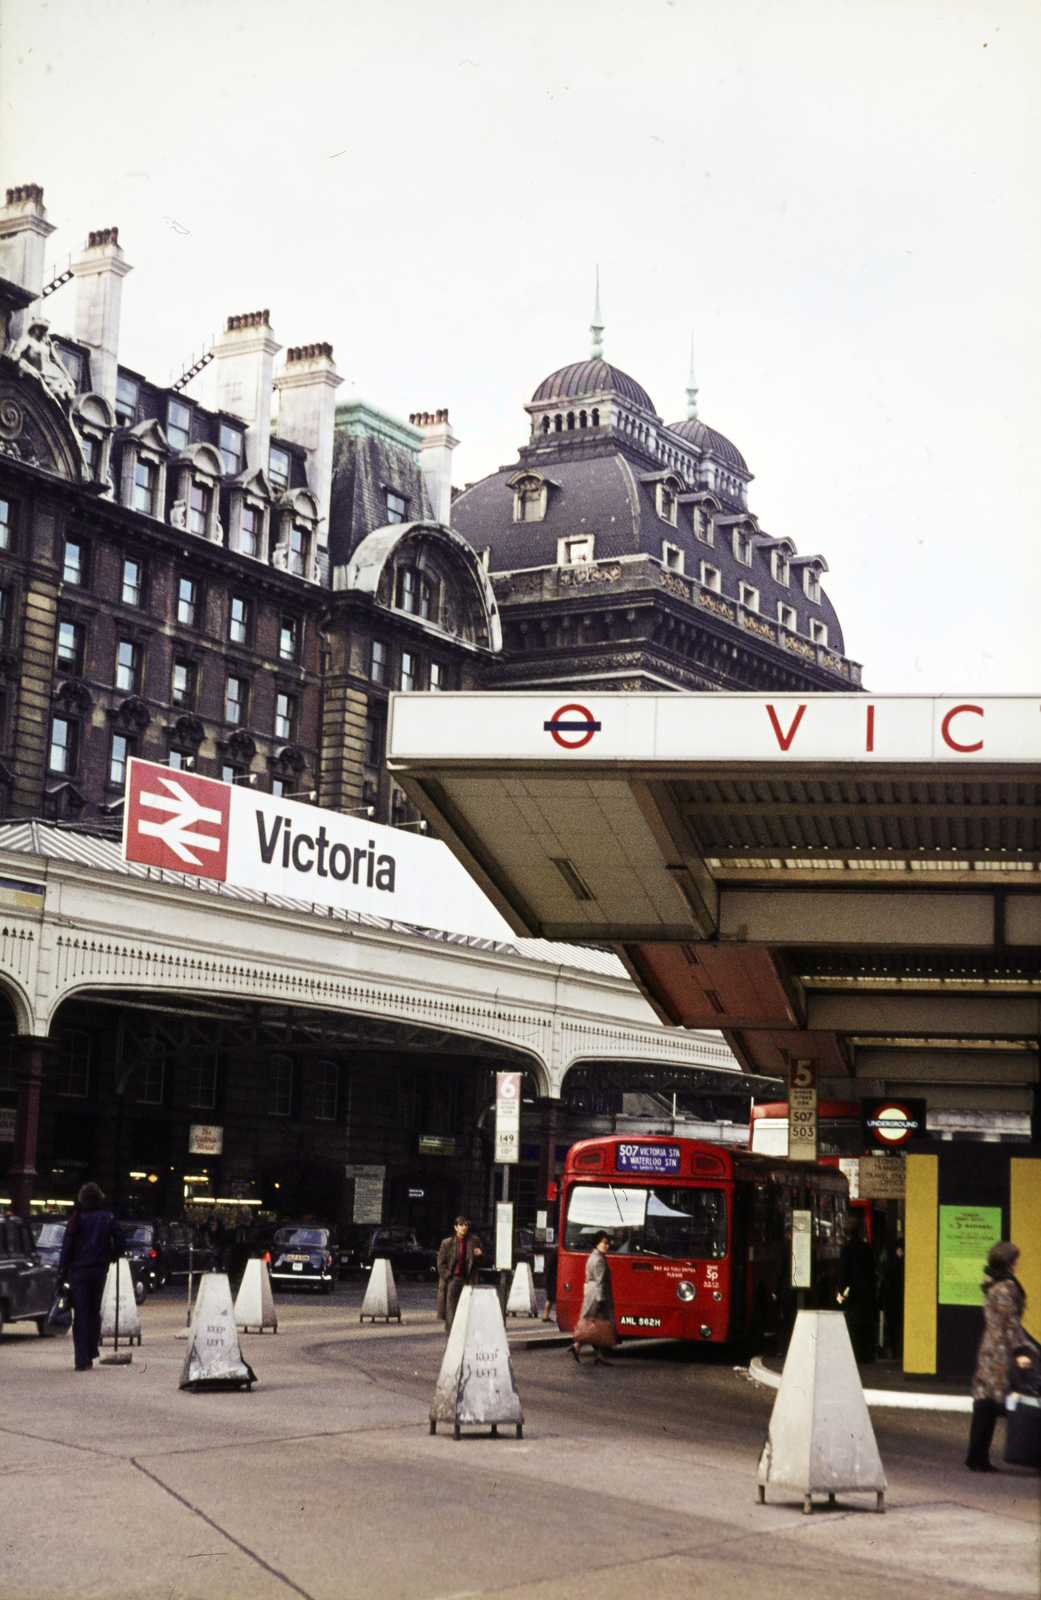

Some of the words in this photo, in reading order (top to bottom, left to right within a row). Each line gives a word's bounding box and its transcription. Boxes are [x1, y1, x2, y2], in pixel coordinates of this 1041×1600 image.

[765, 704, 1041, 753] VIC
[255, 809, 396, 893] Victoria
[794, 1060, 812, 1087] 5
[500, 1075, 516, 1099] 6
[793, 1112, 813, 1121] 507
[867, 1120, 918, 1128] UNDERGROUND
[792, 1127, 814, 1137] 503
[619, 1144, 639, 1156] 507
[640, 1147, 666, 1156] VICTORIA
[669, 1148, 680, 1157] STN
[630, 1156, 662, 1166] WATERLOO
[664, 1158, 677, 1167] STN
[874, 1164, 906, 1172] TRANSPO
[706, 1269, 719, 1281] 5p
[621, 1316, 637, 1325] AML
[638, 1318, 661, 1327] 562H
[207, 1325, 226, 1333] KEEP
[475, 1352, 497, 1361] KEEP
[475, 1368, 498, 1378] LEFT
